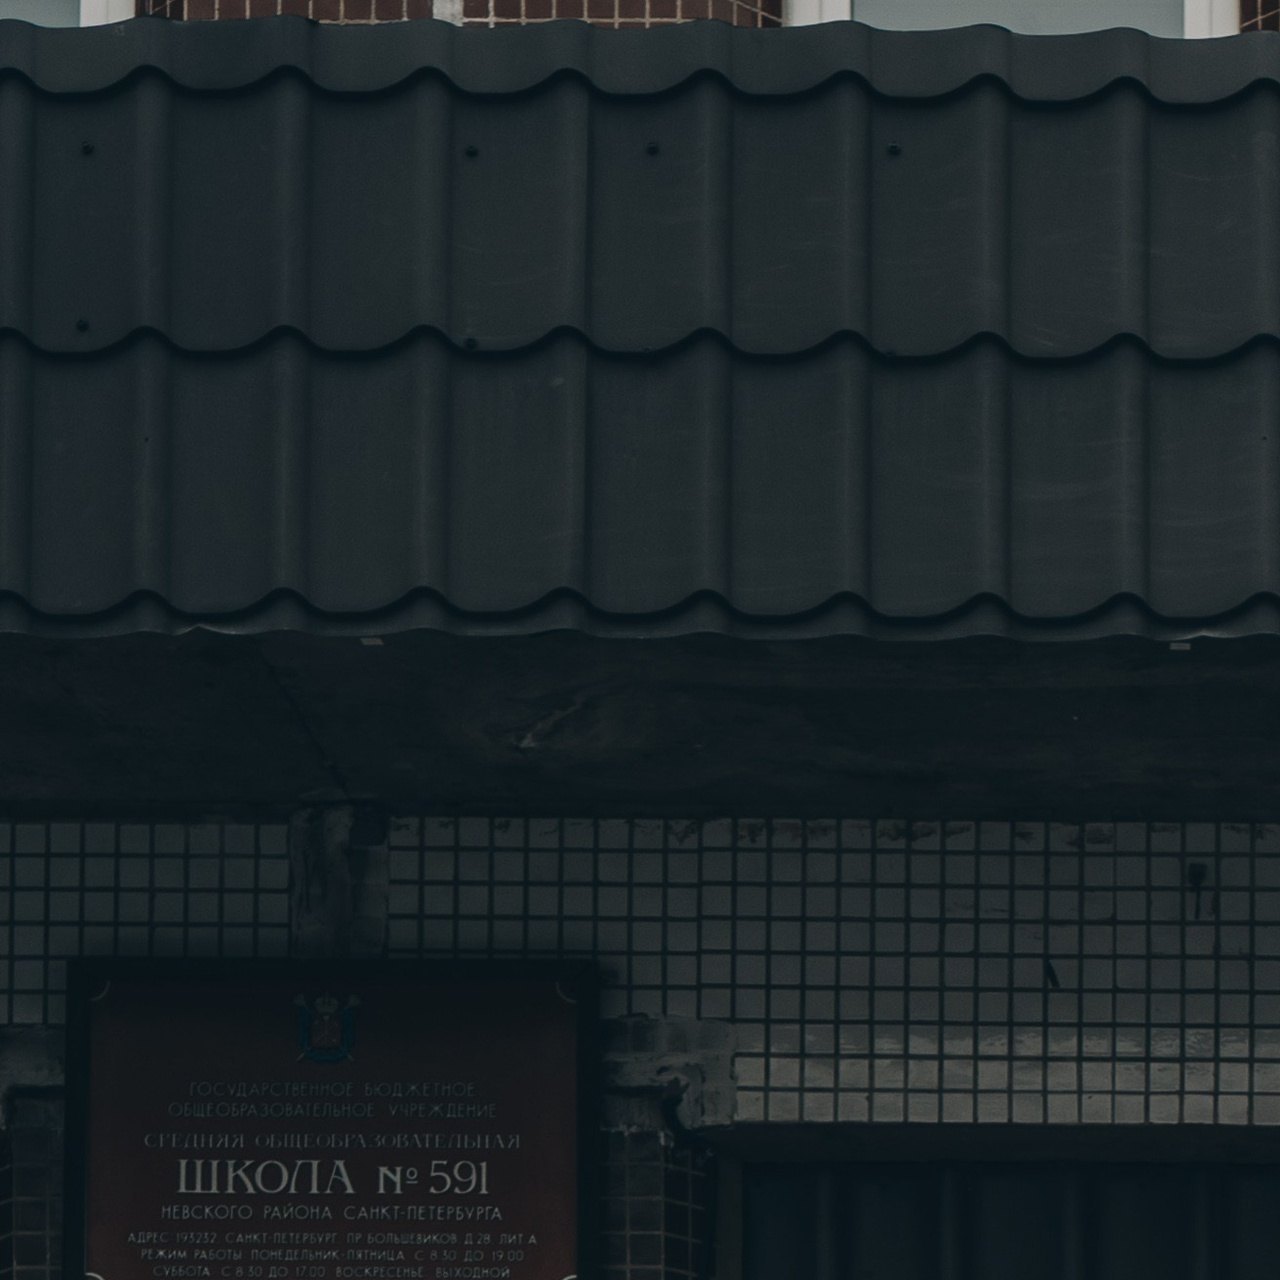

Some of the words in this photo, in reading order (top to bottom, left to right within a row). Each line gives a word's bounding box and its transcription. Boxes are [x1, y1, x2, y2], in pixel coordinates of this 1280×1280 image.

[189, 1081, 355, 1098] ГОСУДАРСТВЕННОЕ
[363, 1081, 476, 1098] БЮДЖЕТНОЕ
[168, 1102, 375, 1118] ОБЩЕОБРАЗОВАТЕЛЬНОЕ
[389, 1102, 497, 1118] УЧРЕЖДЕНИЕ
[143, 1132, 245, 1149] СРЕДНЯЯ
[255, 1132, 521, 1150] ОБЩЕОБРАЗОВАТЕЛЬНАЯ
[177, 1157, 356, 1195] ШКОЛА
[377, 1165, 419, 1195] №
[429, 1159, 490, 1195] 591
[161, 1205, 253, 1220] НЕВСКОГО
[263, 1202, 333, 1220] РАЙОНА
[343, 1204, 503, 1221] САНКТ-ПЕТЕРБУРГА
[127, 1232, 170, 1244] АДРЕС
[367, 1232, 457, 1245] БОЛЬШЕВИКОВ
[528, 1233, 538, 1245] А
[140, 1249, 187, 1261] РЕЖИМ
[194, 1249, 242, 1261] РАБОТЫ
[414, 1250, 424, 1262] С
[463, 1249, 484, 1263] ДО
[153, 1265, 211, 1278] СУББОТА
[221, 1266, 232, 1278] С
[267, 1266, 288, 1279] ДО
[335, 1265, 424, 1279] ВОСКРЕСЕНЬЕ
[435, 1264, 511, 1279] ВЫХОДНОЙ
